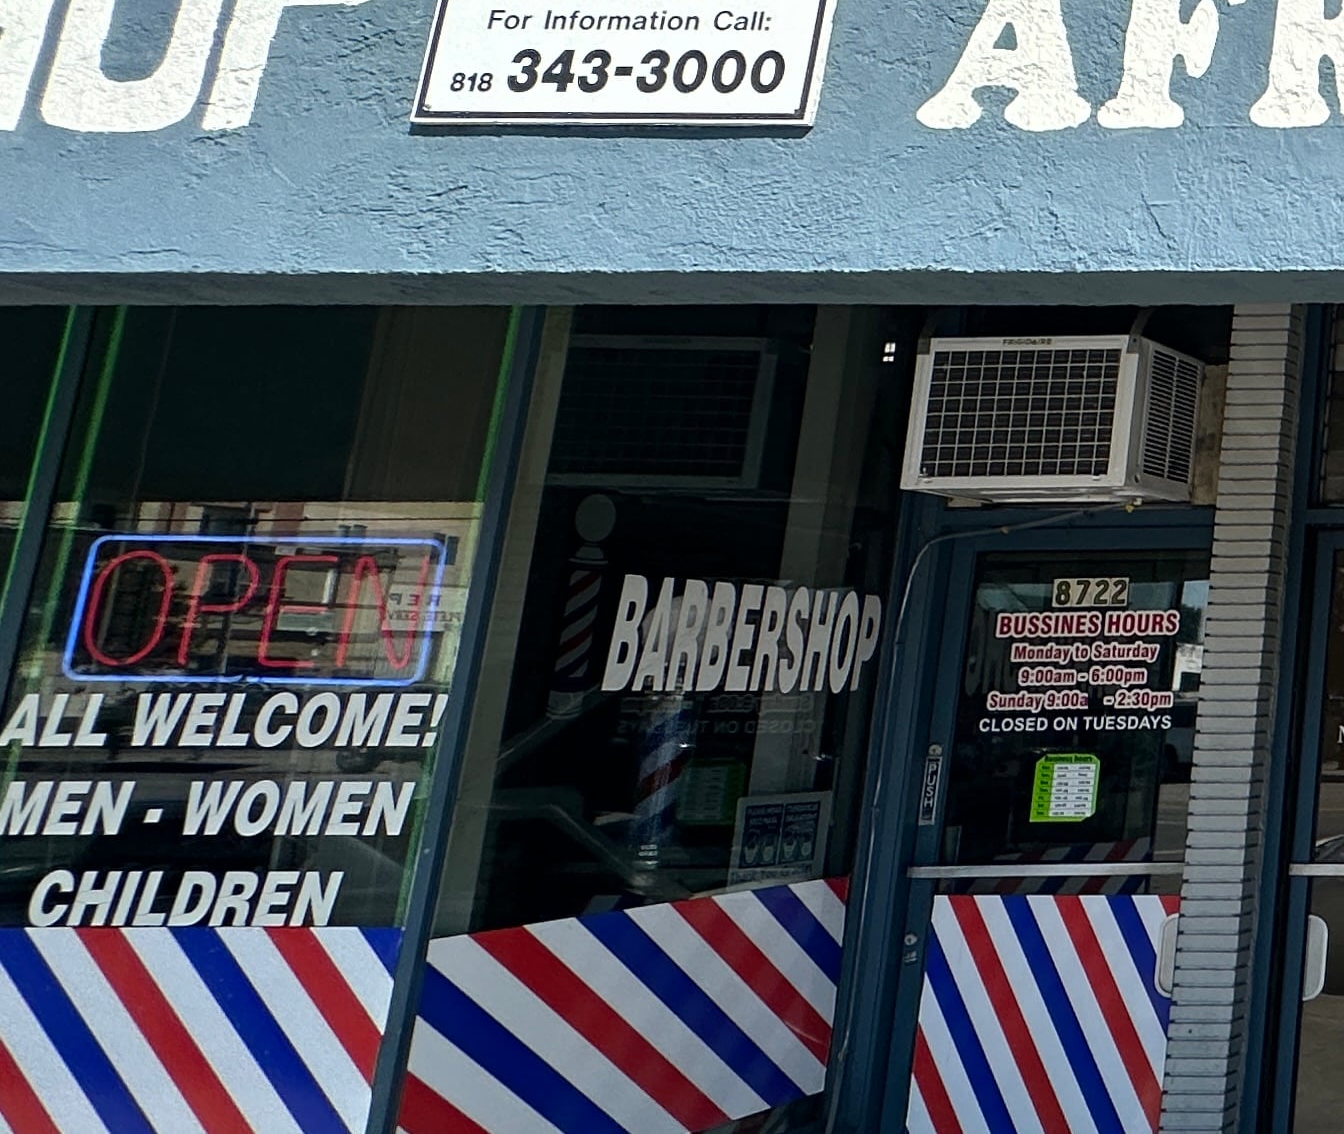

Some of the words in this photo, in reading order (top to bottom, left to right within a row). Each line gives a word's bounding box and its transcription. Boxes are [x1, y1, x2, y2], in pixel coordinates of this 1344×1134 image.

[487, 10, 533, 30] For
[544, 10, 699, 31] Information
[713, 11, 772, 32] Call:
[449, 72, 493, 93] 818
[507, 49, 786, 95] 343-3000
[82, 550, 433, 670] OPEN
[1054, 579, 1129, 606] 8722
[601, 574, 882, 694] BARBERSHOP
[998, 613, 1102, 636] BUSSINES
[1107, 612, 1178, 634] HOURS
[1012, 643, 1070, 663] Monday
[1074, 645, 1089, 660] to
[1092, 643, 1159, 663] Saturday
[1020, 669, 1075, 685] 9:00am
[1090, 669, 1146, 687] 6:00pm
[989, 692, 1043, 711] Sunday
[1046, 692, 1089, 708] 9:00a
[1116, 690, 1173, 709] 2:30pm
[0, 693, 107, 747] ALL
[131, 693, 448, 748] WELCOME!
[979, 718, 1049, 732] CLOSED
[1053, 717, 1078, 731] ON
[1083, 715, 1172, 731] TUESDAYS
[923, 763, 938, 809] PUSH
[0, 781, 136, 835] MEN
[183, 781, 415, 836] WOMEN
[28, 870, 344, 926] CHILDREN
